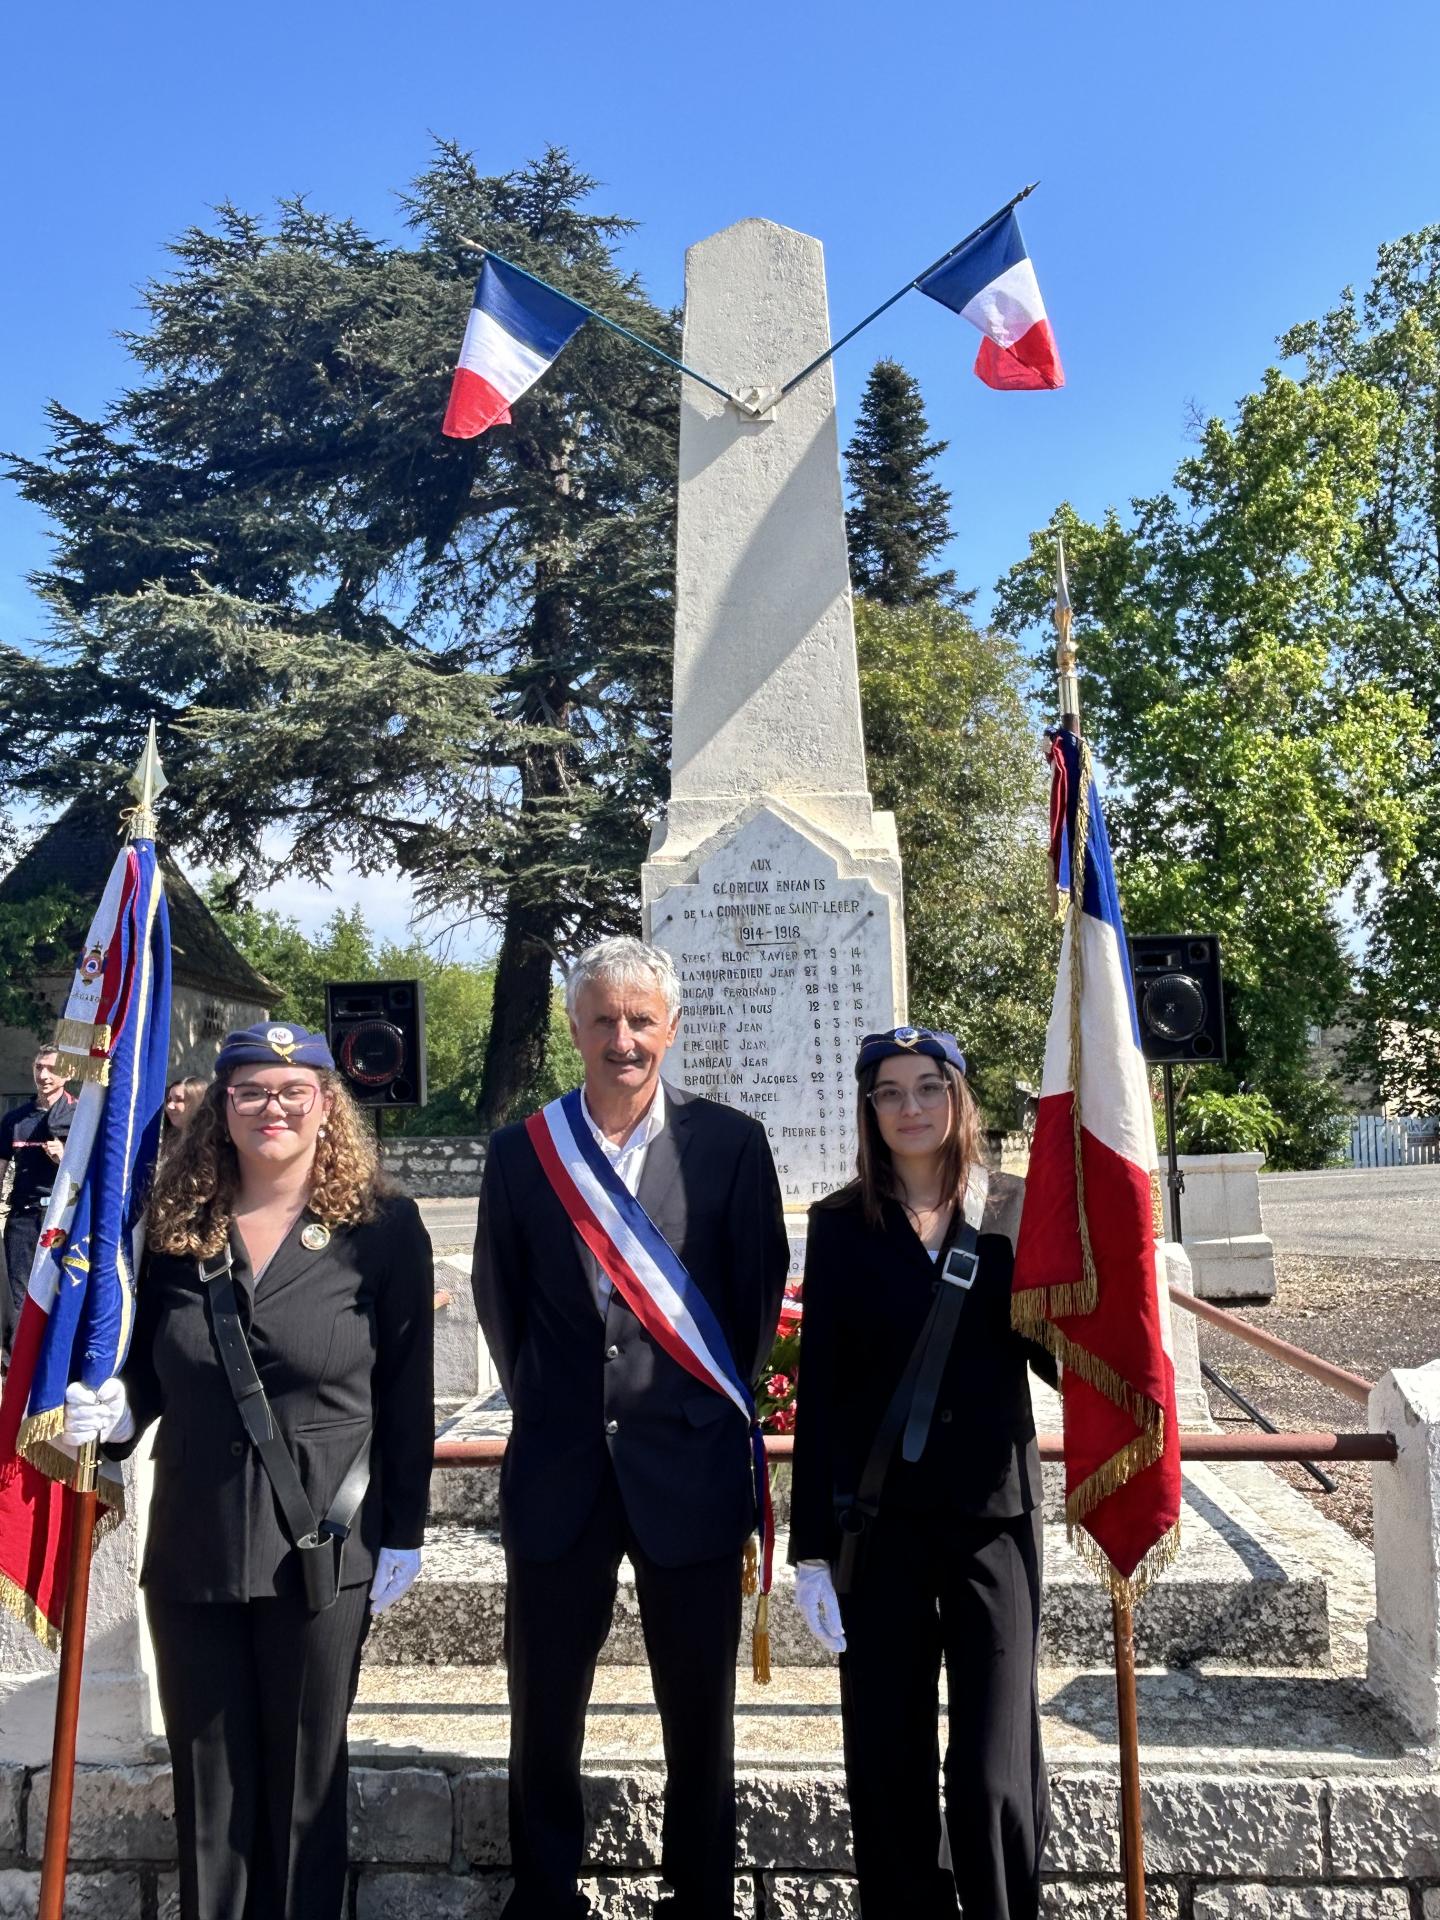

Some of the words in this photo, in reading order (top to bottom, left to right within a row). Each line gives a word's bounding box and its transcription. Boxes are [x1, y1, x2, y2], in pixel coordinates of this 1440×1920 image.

[750, 859, 772, 873] AUX
[713, 880, 769, 894] GLORIEUX
[776, 879, 825, 892] ENFANTS
[684, 910, 696, 919] DE
[700, 909, 714, 919] LA
[717, 904, 772, 917] COMMUNE
[775, 906, 786, 915] DE
[722, 951, 750, 962] BLOC
[770, 967, 795, 978] JEAN
[683, 1022, 727, 1034] OLIVIER
[736, 1021, 763, 1033] JEAN
[740, 1038, 767, 1050] JEAN
[741, 1056, 768, 1068] JEAN
[740, 1091, 779, 1103] MARCEL
[782, 1126, 817, 1137] PIERRE
[786, 1185, 800, 1195] LA
[812, 1181, 849, 1194] FRAN
